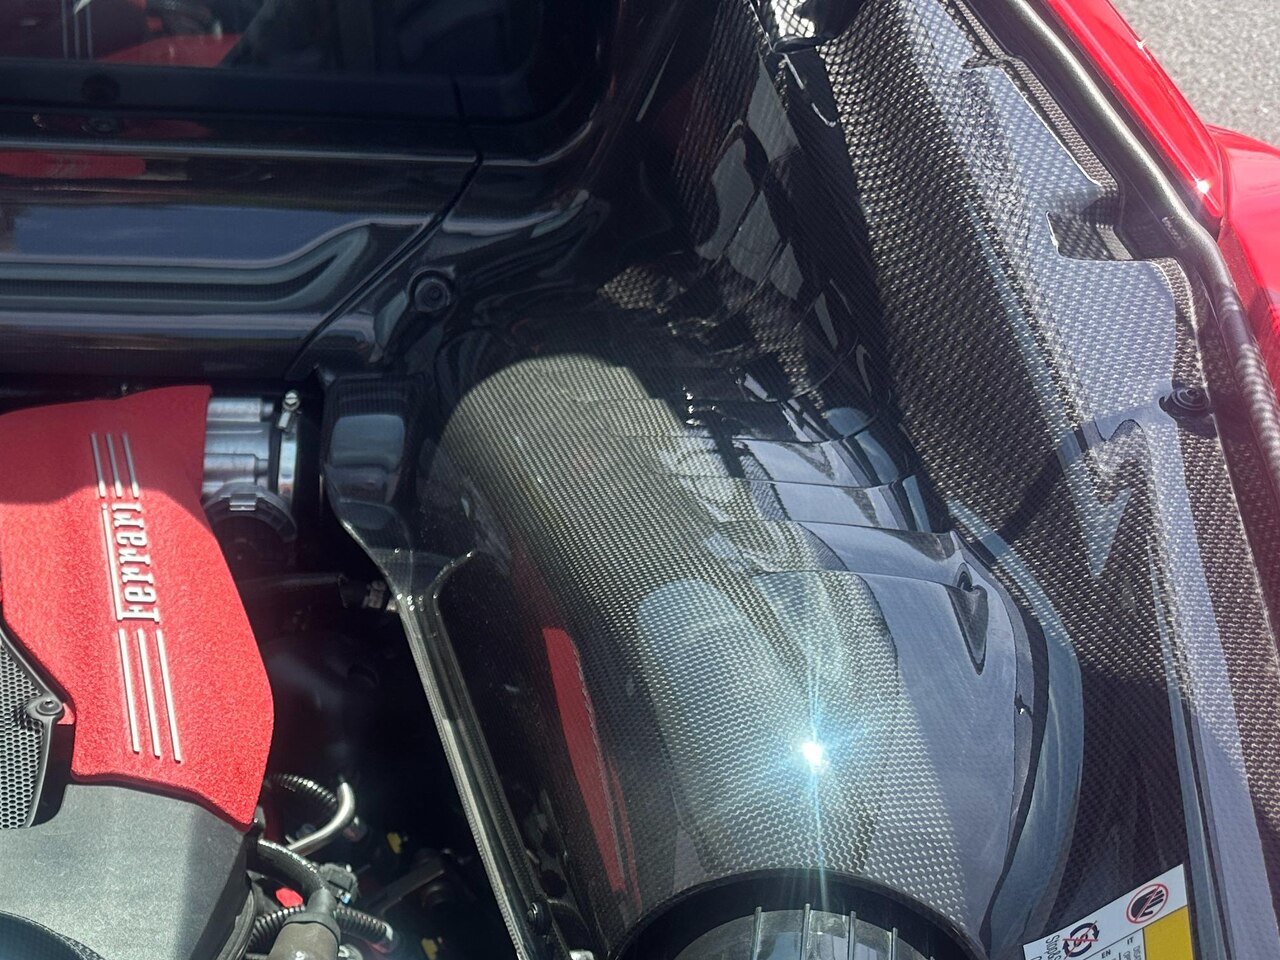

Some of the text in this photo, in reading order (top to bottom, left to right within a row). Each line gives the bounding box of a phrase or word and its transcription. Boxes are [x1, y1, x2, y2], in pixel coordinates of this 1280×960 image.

[100, 502, 160, 622] Ferrari
[1126, 936, 1133, 945] IT
[1101, 948, 1111, 959] EN
